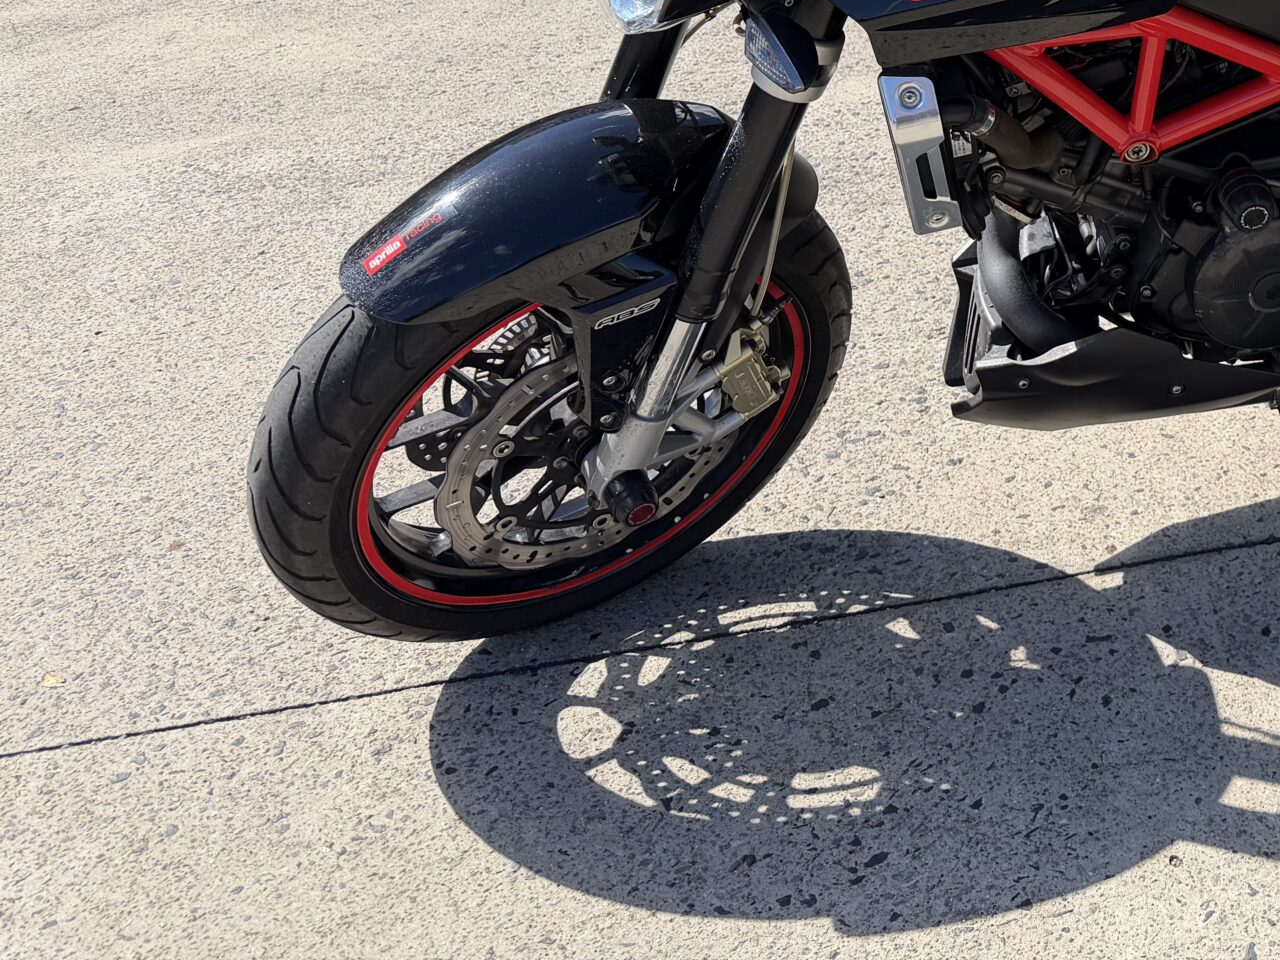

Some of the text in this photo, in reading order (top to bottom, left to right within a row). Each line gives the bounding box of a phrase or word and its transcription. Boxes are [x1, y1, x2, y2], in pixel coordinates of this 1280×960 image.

[368, 212, 444, 269] aprilia racing
[594, 297, 661, 330] ABS
